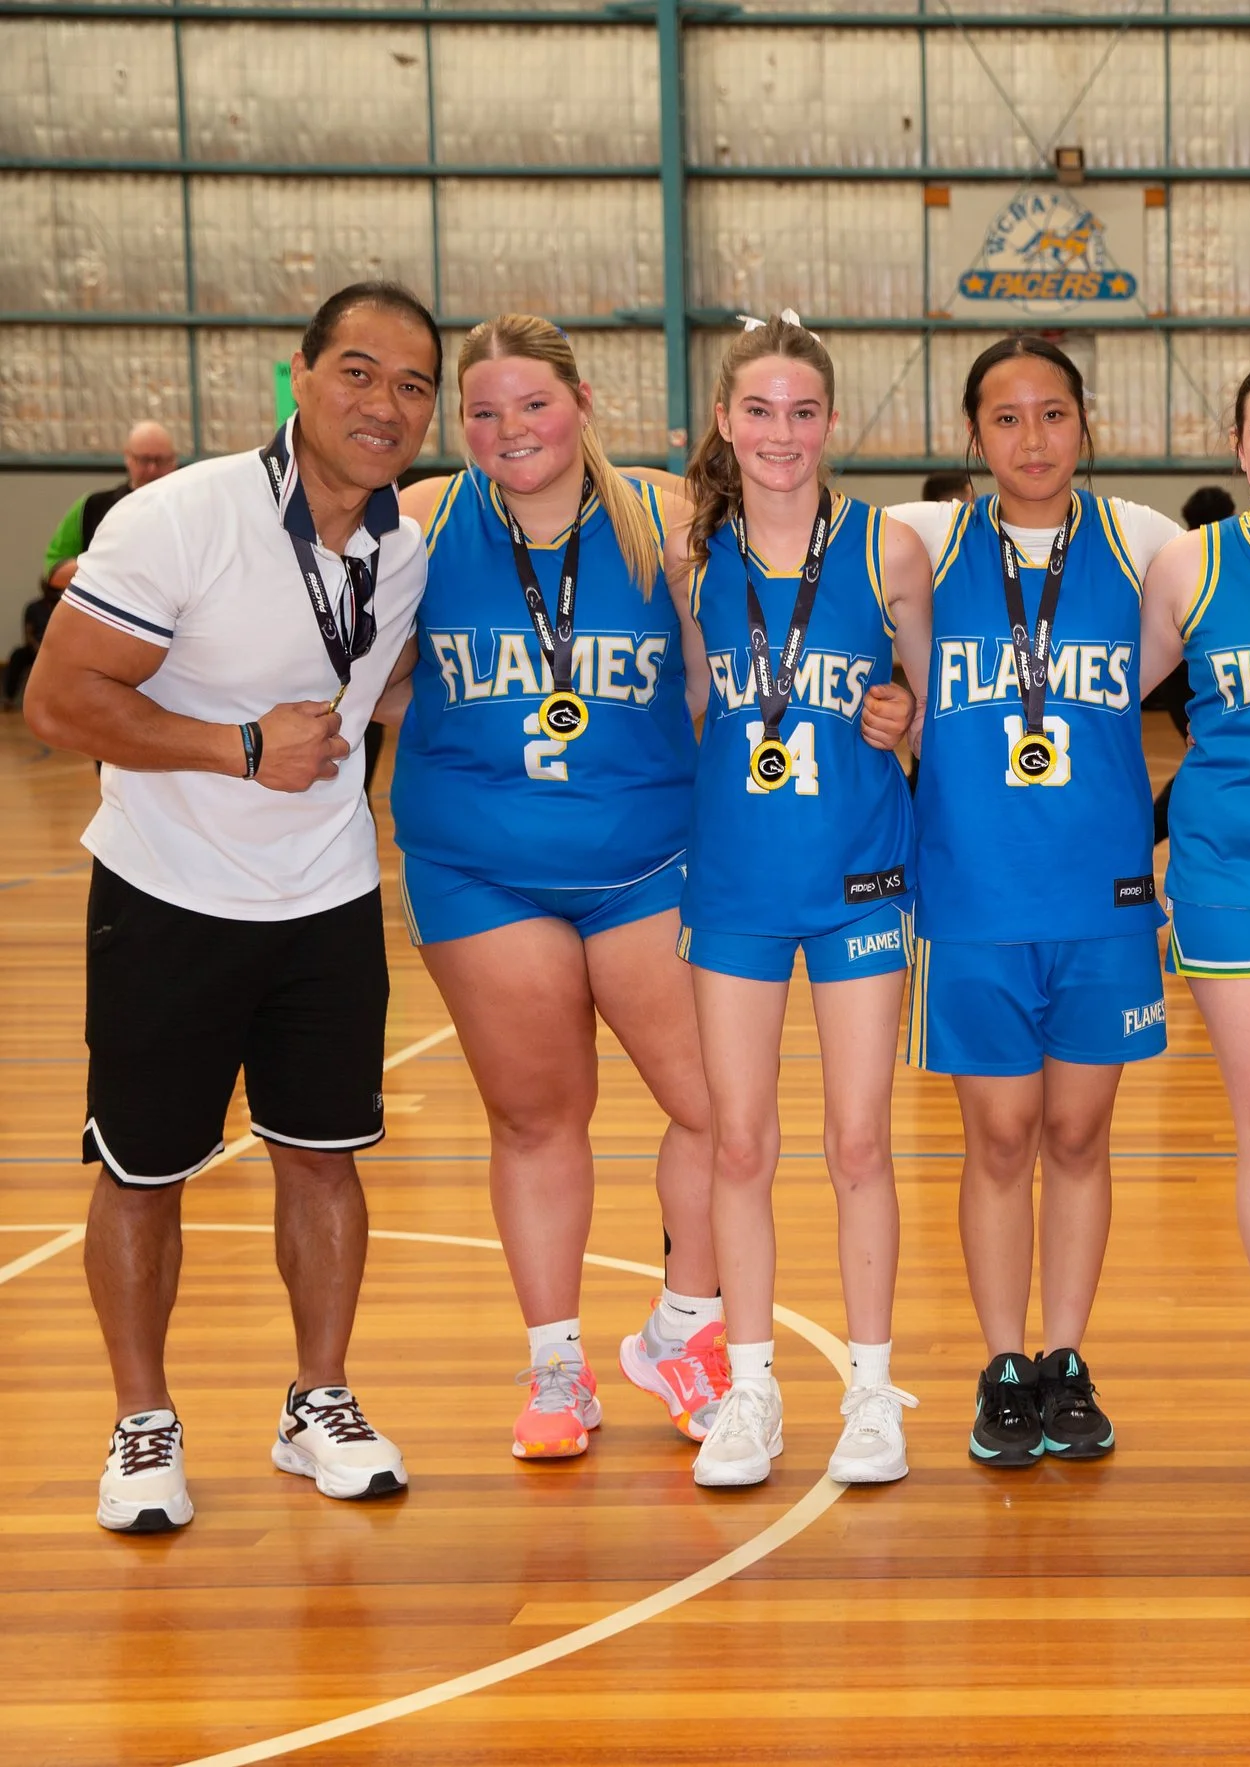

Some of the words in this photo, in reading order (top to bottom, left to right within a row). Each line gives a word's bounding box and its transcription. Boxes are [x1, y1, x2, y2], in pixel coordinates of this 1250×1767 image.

[989, 273, 1102, 298] PACERS
[813, 518, 826, 558] PACERS
[1004, 540, 1014, 579] PACERS
[308, 572, 327, 613] PACERS
[562, 576, 572, 615] PACERS
[535, 612, 554, 651] PACERS
[786, 628, 800, 669] PACERS
[1038, 620, 1048, 661] PACERS
[430, 634, 667, 704] FLAMES
[758, 655, 770, 697] PACERS
[940, 641, 1131, 711] FLAMES
[523, 712, 568, 781] 2
[746, 721, 818, 795] 14
[885, 875, 900, 888] XS
[846, 929, 901, 960] FLAMES
